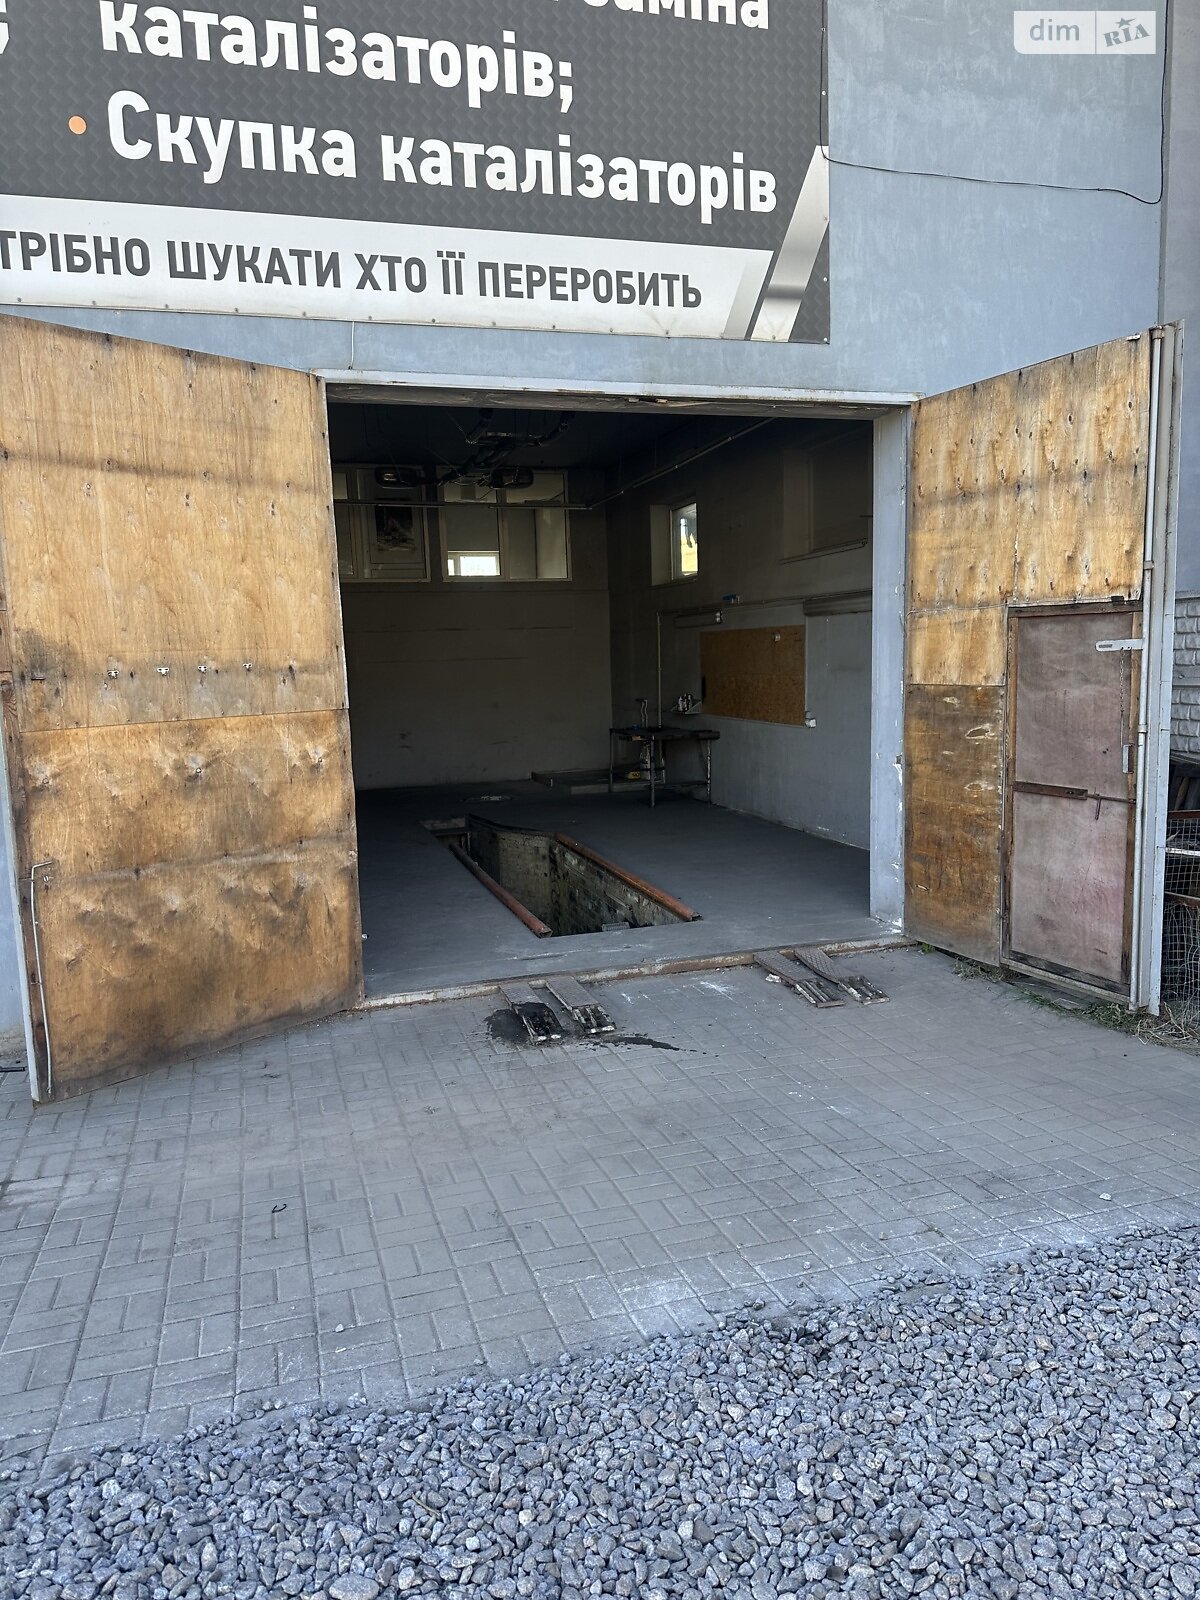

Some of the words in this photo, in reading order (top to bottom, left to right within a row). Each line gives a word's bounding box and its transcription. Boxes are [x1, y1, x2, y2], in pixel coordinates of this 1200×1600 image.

[100, 0, 573, 114] каталізаторів;
[107, 90, 357, 184] Скупка
[381, 134, 777, 224] каталізаторів
[166, 241, 341, 289] ШУКАТИ
[355, 254, 427, 293] ХТО
[437, 250, 466, 295] ЇЇ
[478, 262, 702, 308] ПЕРЕРОБИТЬ
